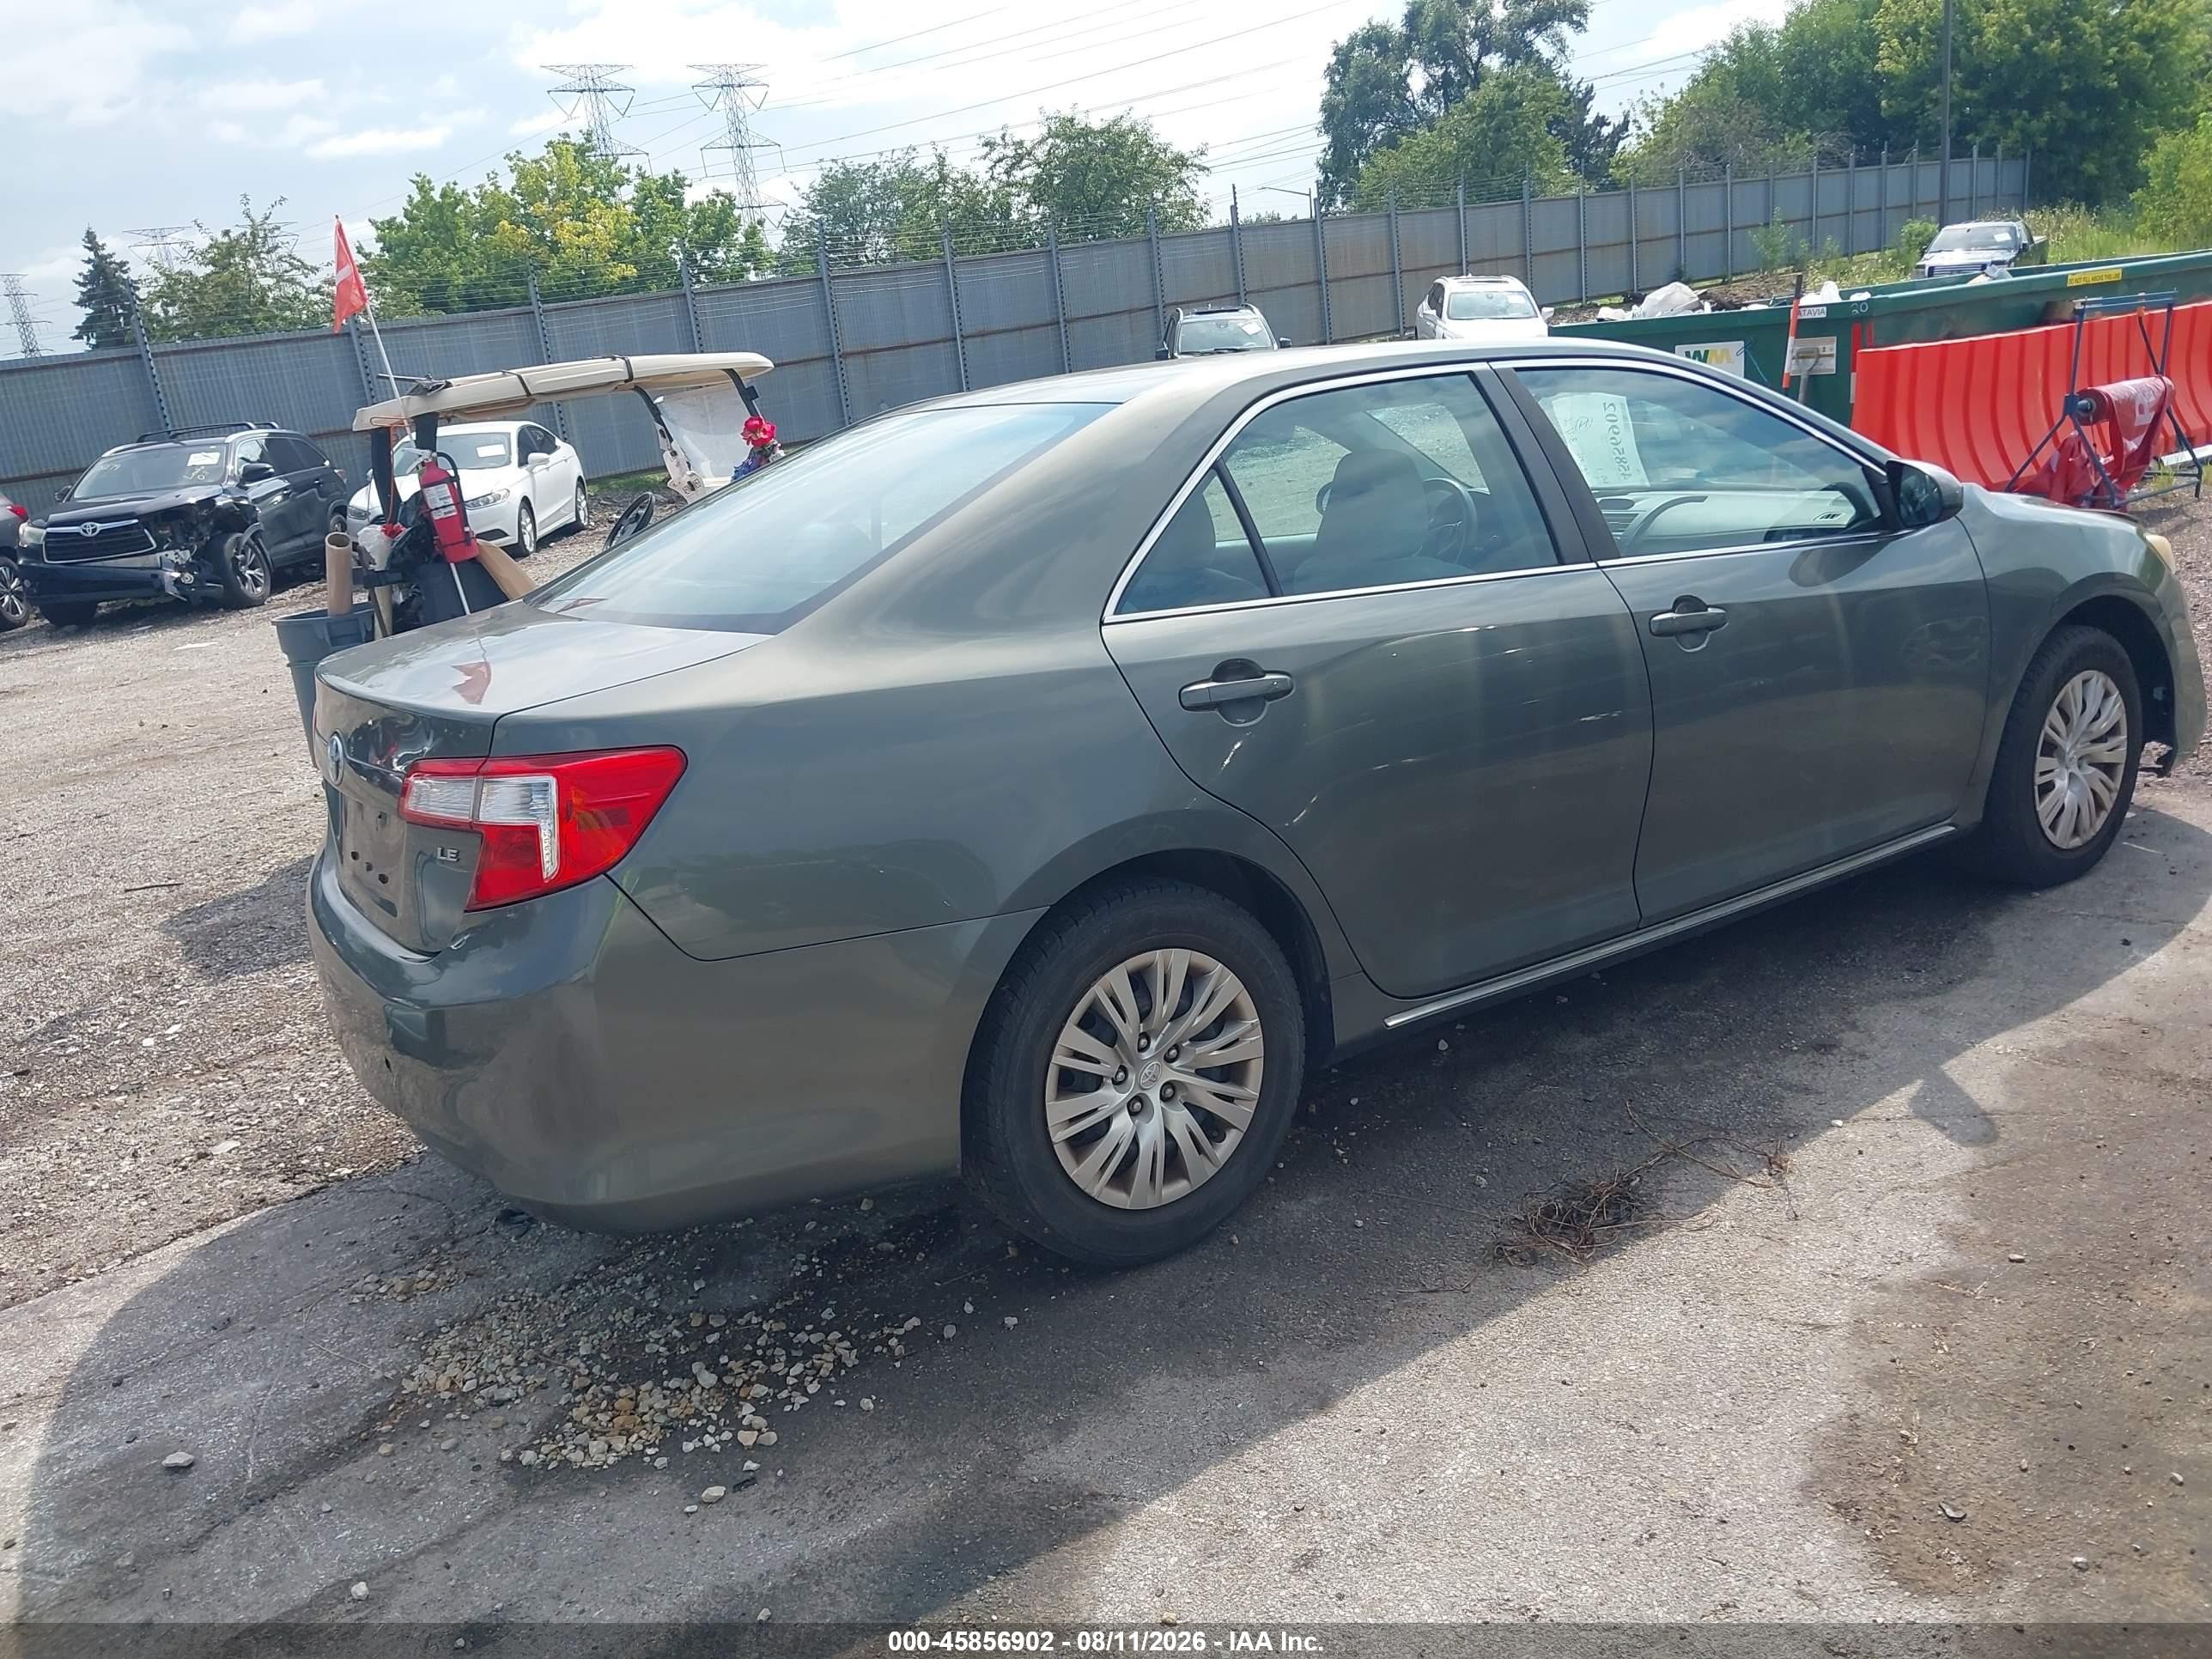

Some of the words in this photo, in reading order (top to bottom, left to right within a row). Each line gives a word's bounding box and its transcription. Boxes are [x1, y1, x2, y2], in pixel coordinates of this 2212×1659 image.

[1797, 308, 1826, 317] ATAVIA
[1684, 349, 1732, 364] WM
[437, 847, 459, 862] LE
